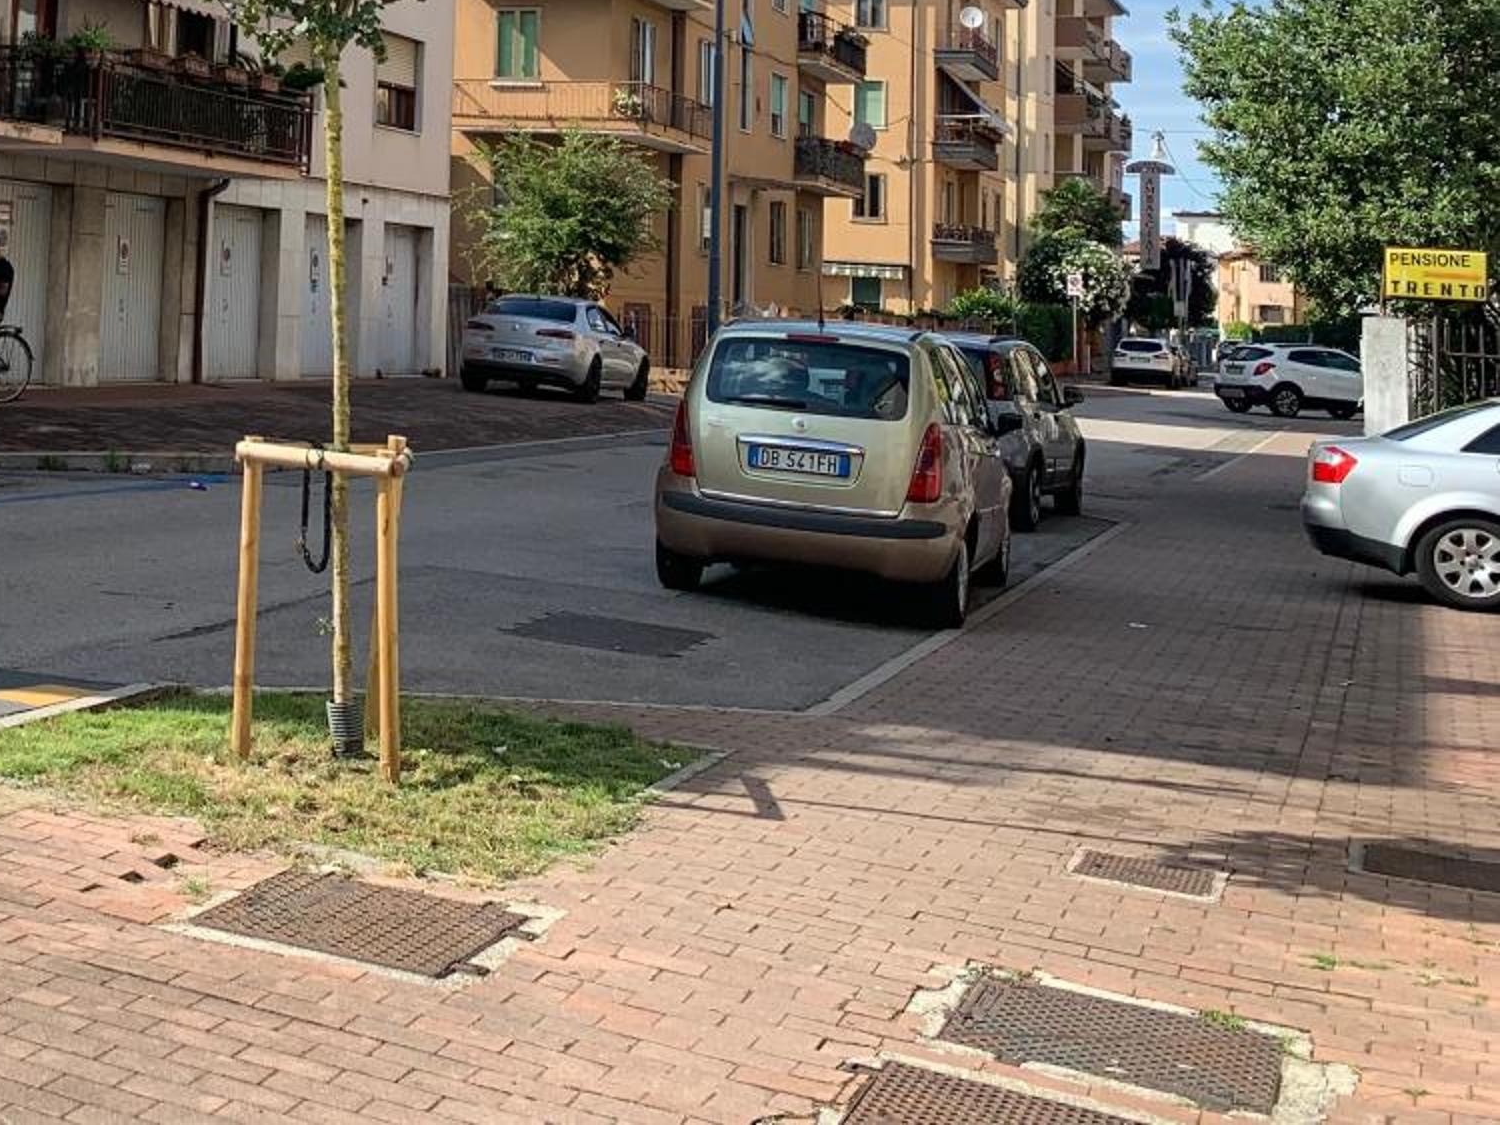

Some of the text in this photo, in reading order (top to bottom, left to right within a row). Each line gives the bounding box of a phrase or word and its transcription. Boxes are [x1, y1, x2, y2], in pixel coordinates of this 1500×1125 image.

[1389, 252, 1471, 268] PENSIONE
[1390, 280, 1485, 298] TRENTO
[760, 446, 781, 466] DB
